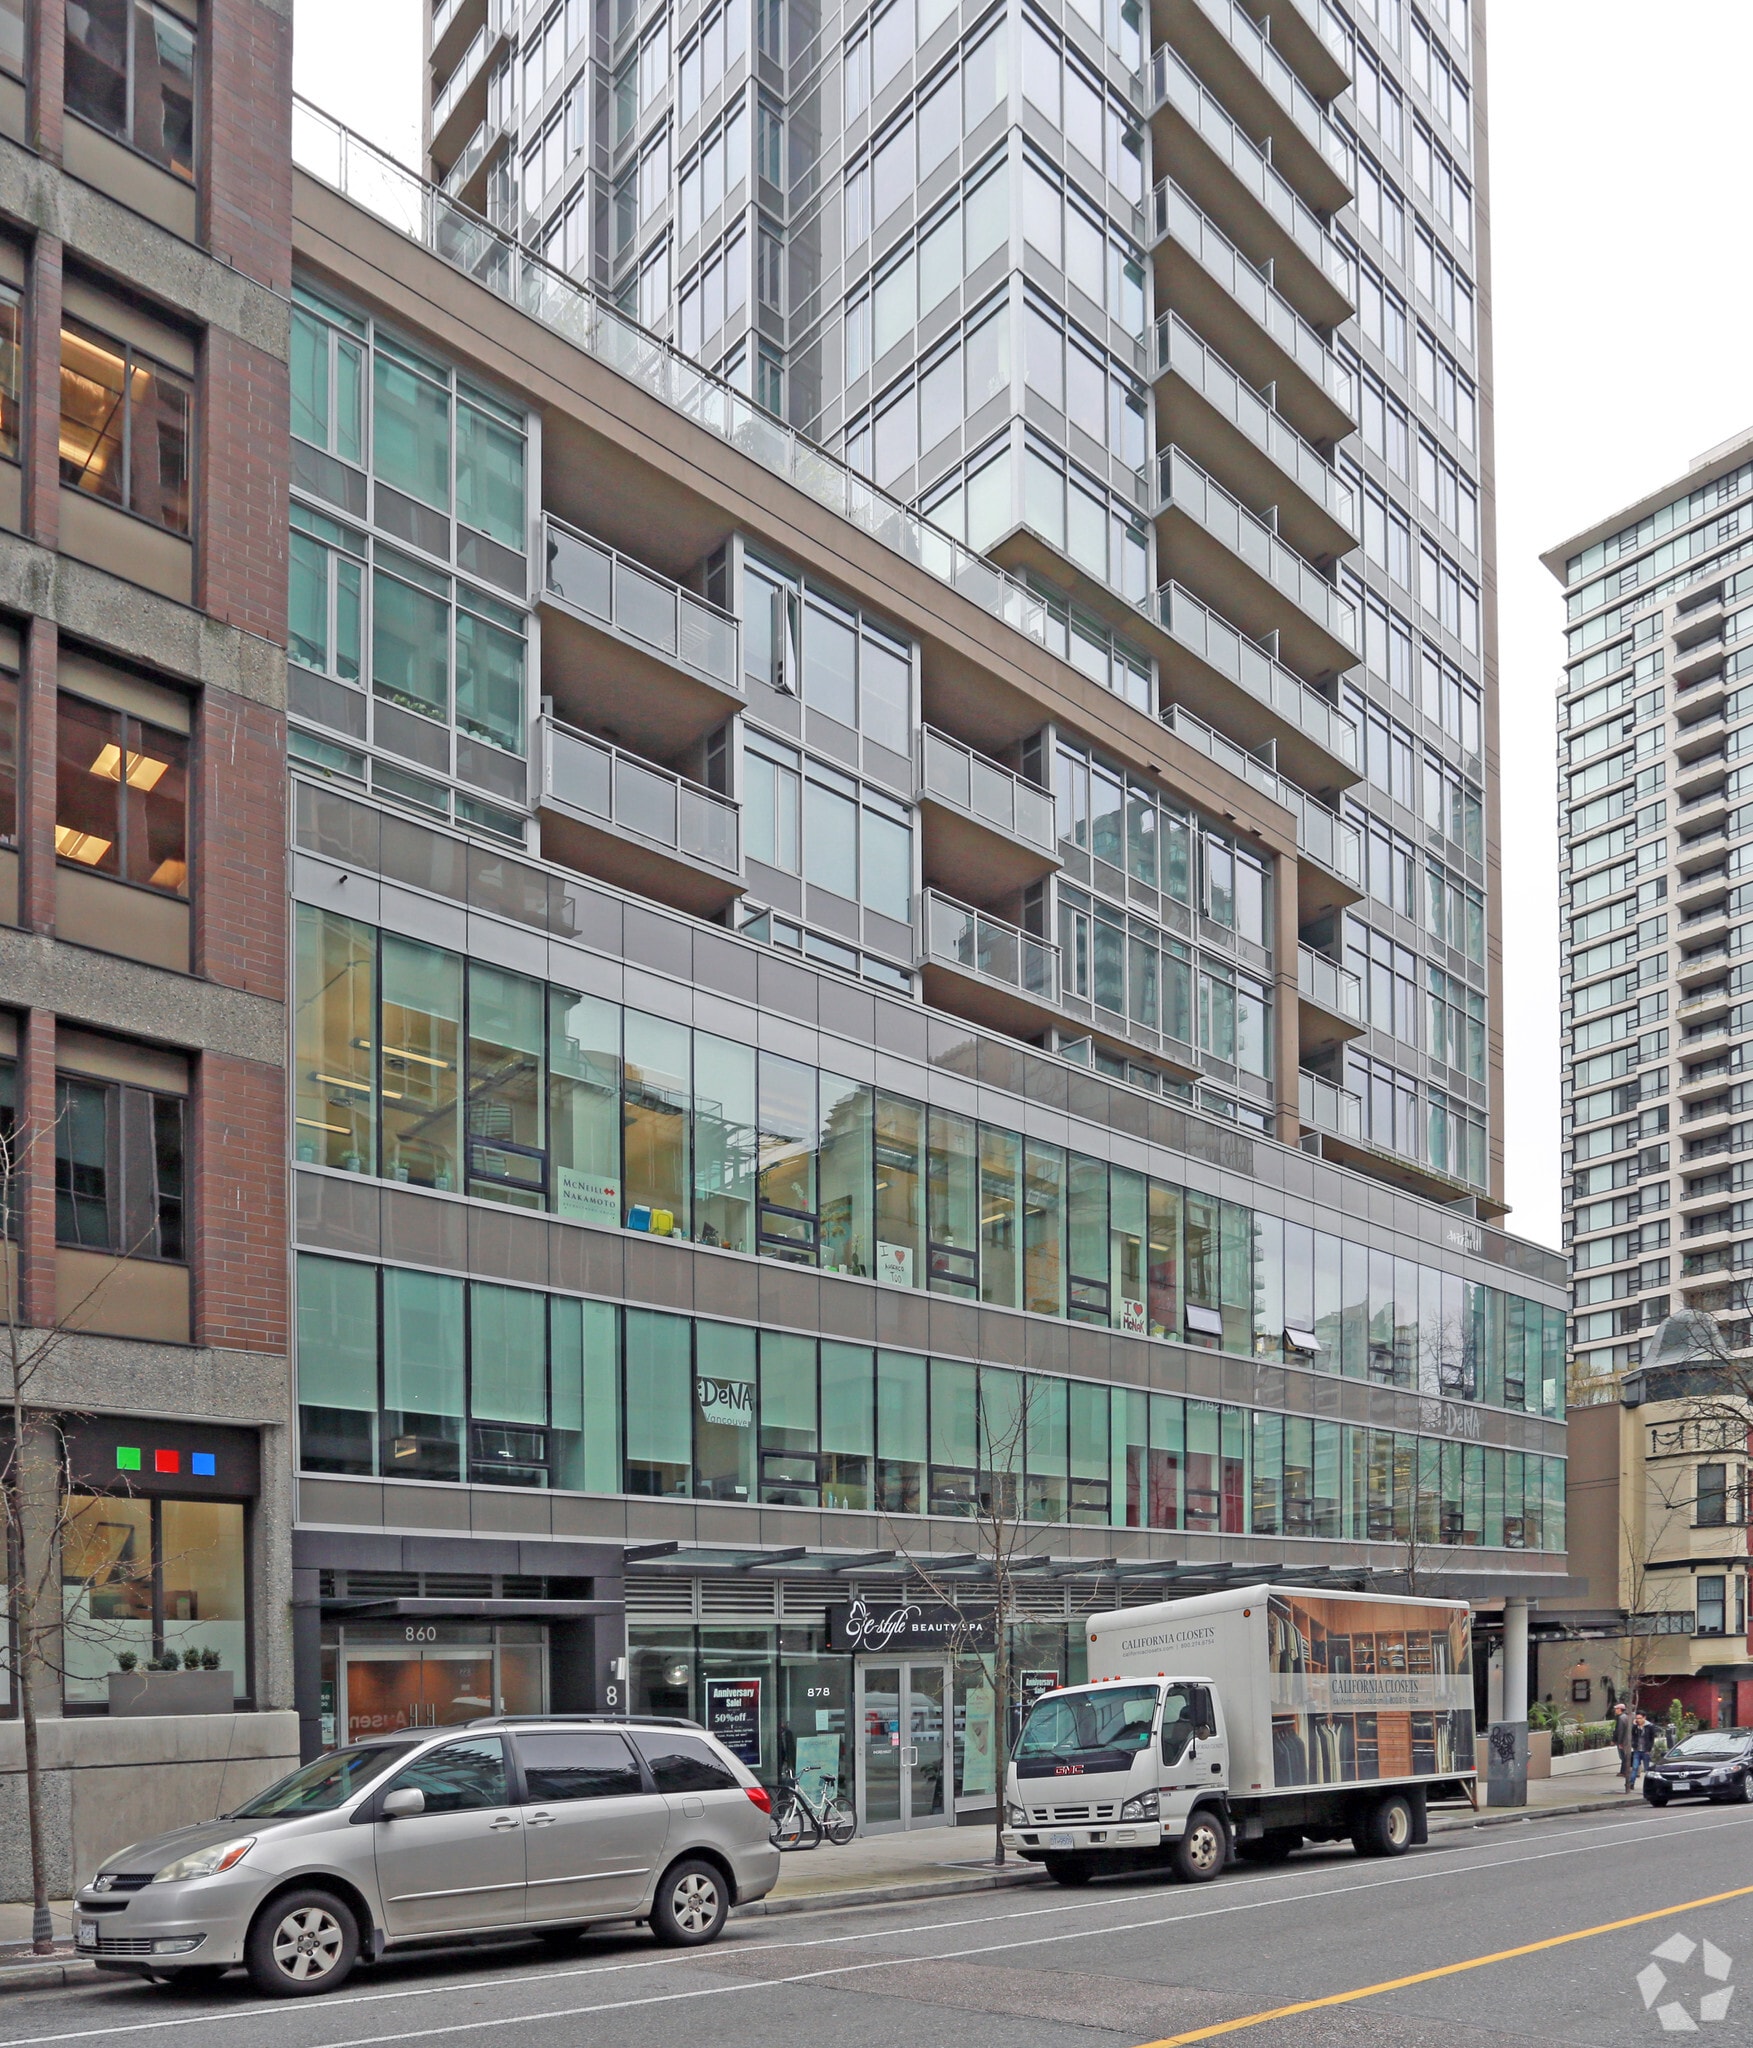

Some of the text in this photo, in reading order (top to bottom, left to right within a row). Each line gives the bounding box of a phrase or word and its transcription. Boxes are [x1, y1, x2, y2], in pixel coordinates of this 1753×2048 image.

[563, 1190, 616, 1208] NAKAMOTO
[1123, 1300, 1132, 1316] I
[705, 1413, 750, 1427] Vancouve
[405, 1626, 437, 1641] 860
[911, 1623, 957, 1632] BEAUTY
[961, 1623, 983, 1632] SPA
[1121, 1626, 1215, 1650] CALIFORNIA CLOSETS
[713, 1688, 755, 1698] Anniversary
[807, 1687, 830, 1697] 878
[1332, 1679, 1419, 1694] CALIFORNIA CLOSETS
[726, 1699, 742, 1708] Sale!
[1055, 1764, 1085, 1775] GMC
